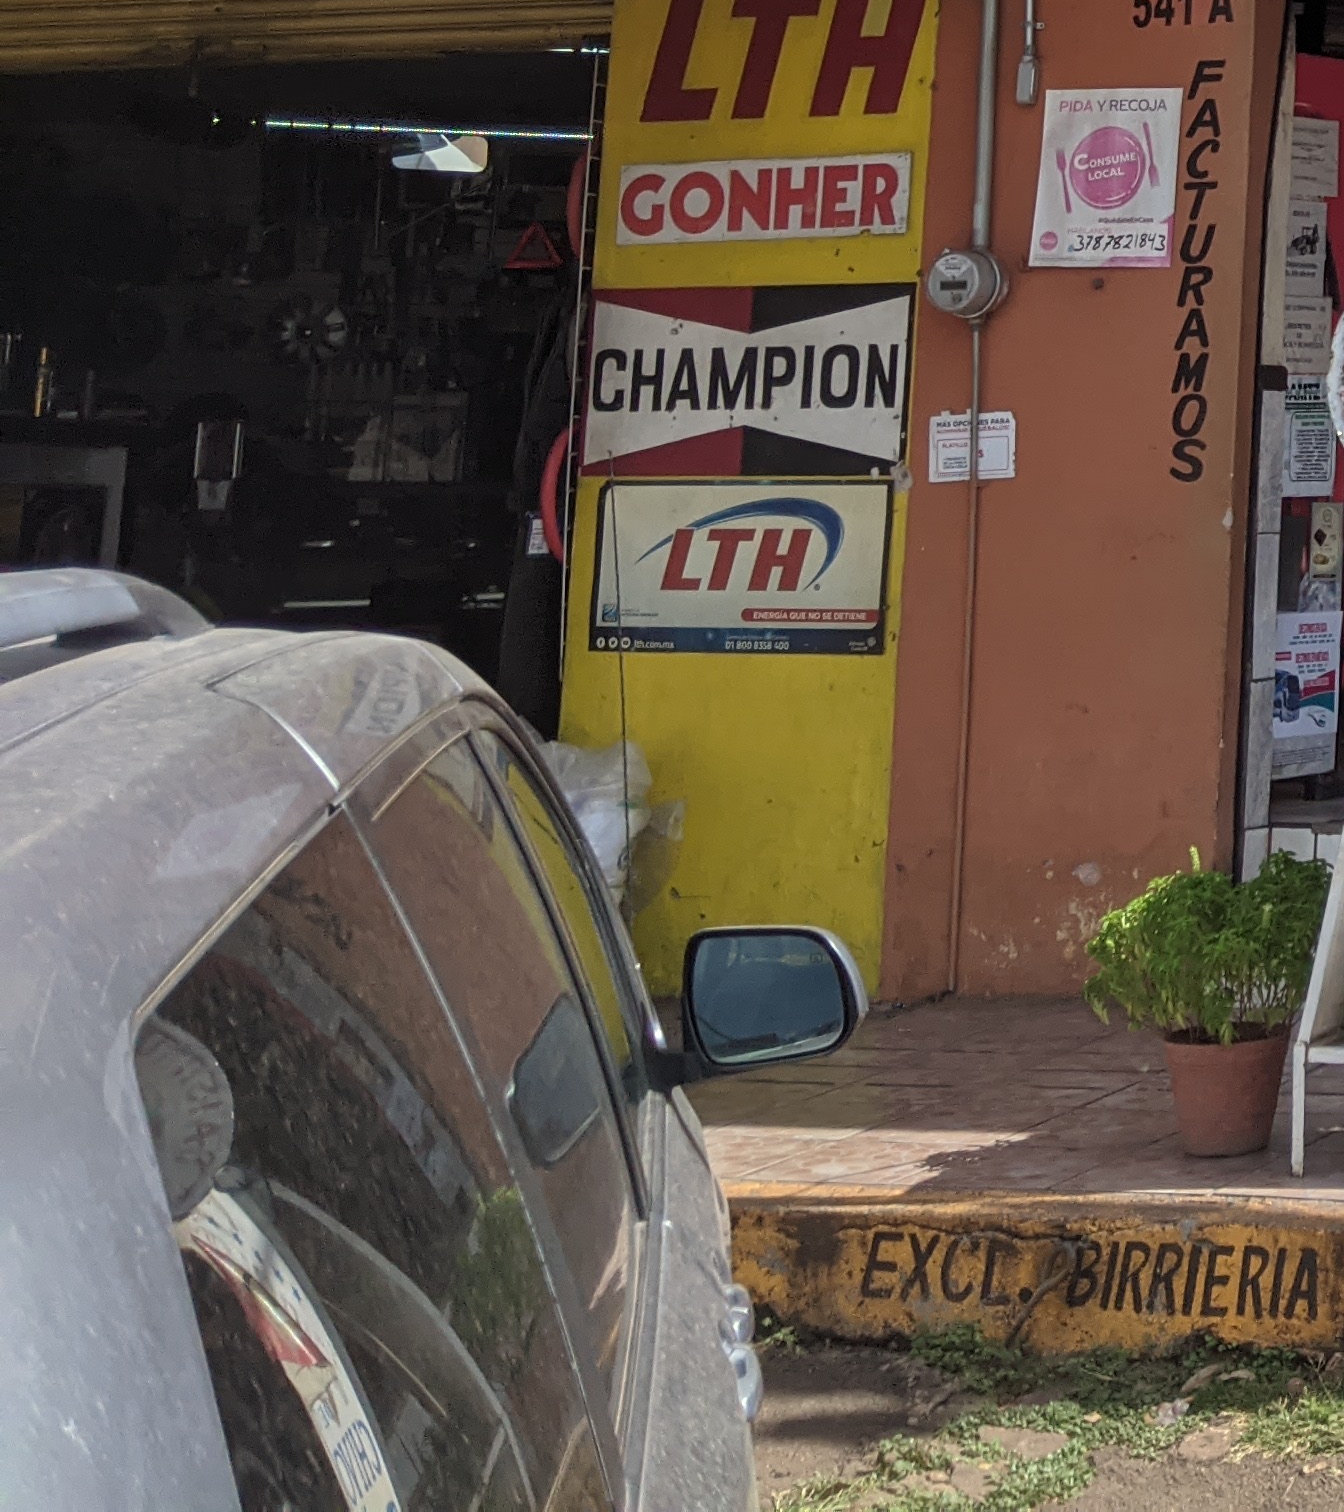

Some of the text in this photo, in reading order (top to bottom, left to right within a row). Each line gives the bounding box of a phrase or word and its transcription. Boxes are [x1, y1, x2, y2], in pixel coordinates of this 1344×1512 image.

[1059, 99, 1168, 113] PIDA Y RECOJA
[1073, 152, 1137, 170] CONSUME
[1088, 168, 1125, 181] LOCAL
[620, 163, 900, 236] GONHER
[1073, 233, 1166, 251] 3787821843
[1170, 59, 1226, 482] FACTURAMOS
[592, 343, 899, 413] CHAMPION
[659, 529, 812, 591] LTH
[753, 608, 788, 621] ENERGÍA
[789, 610, 807, 620] QUE
[808, 610, 821, 620] NO
[833, 610, 867, 621] DETIENE
[1066, 1238, 1319, 1321] BIRRIERIA
